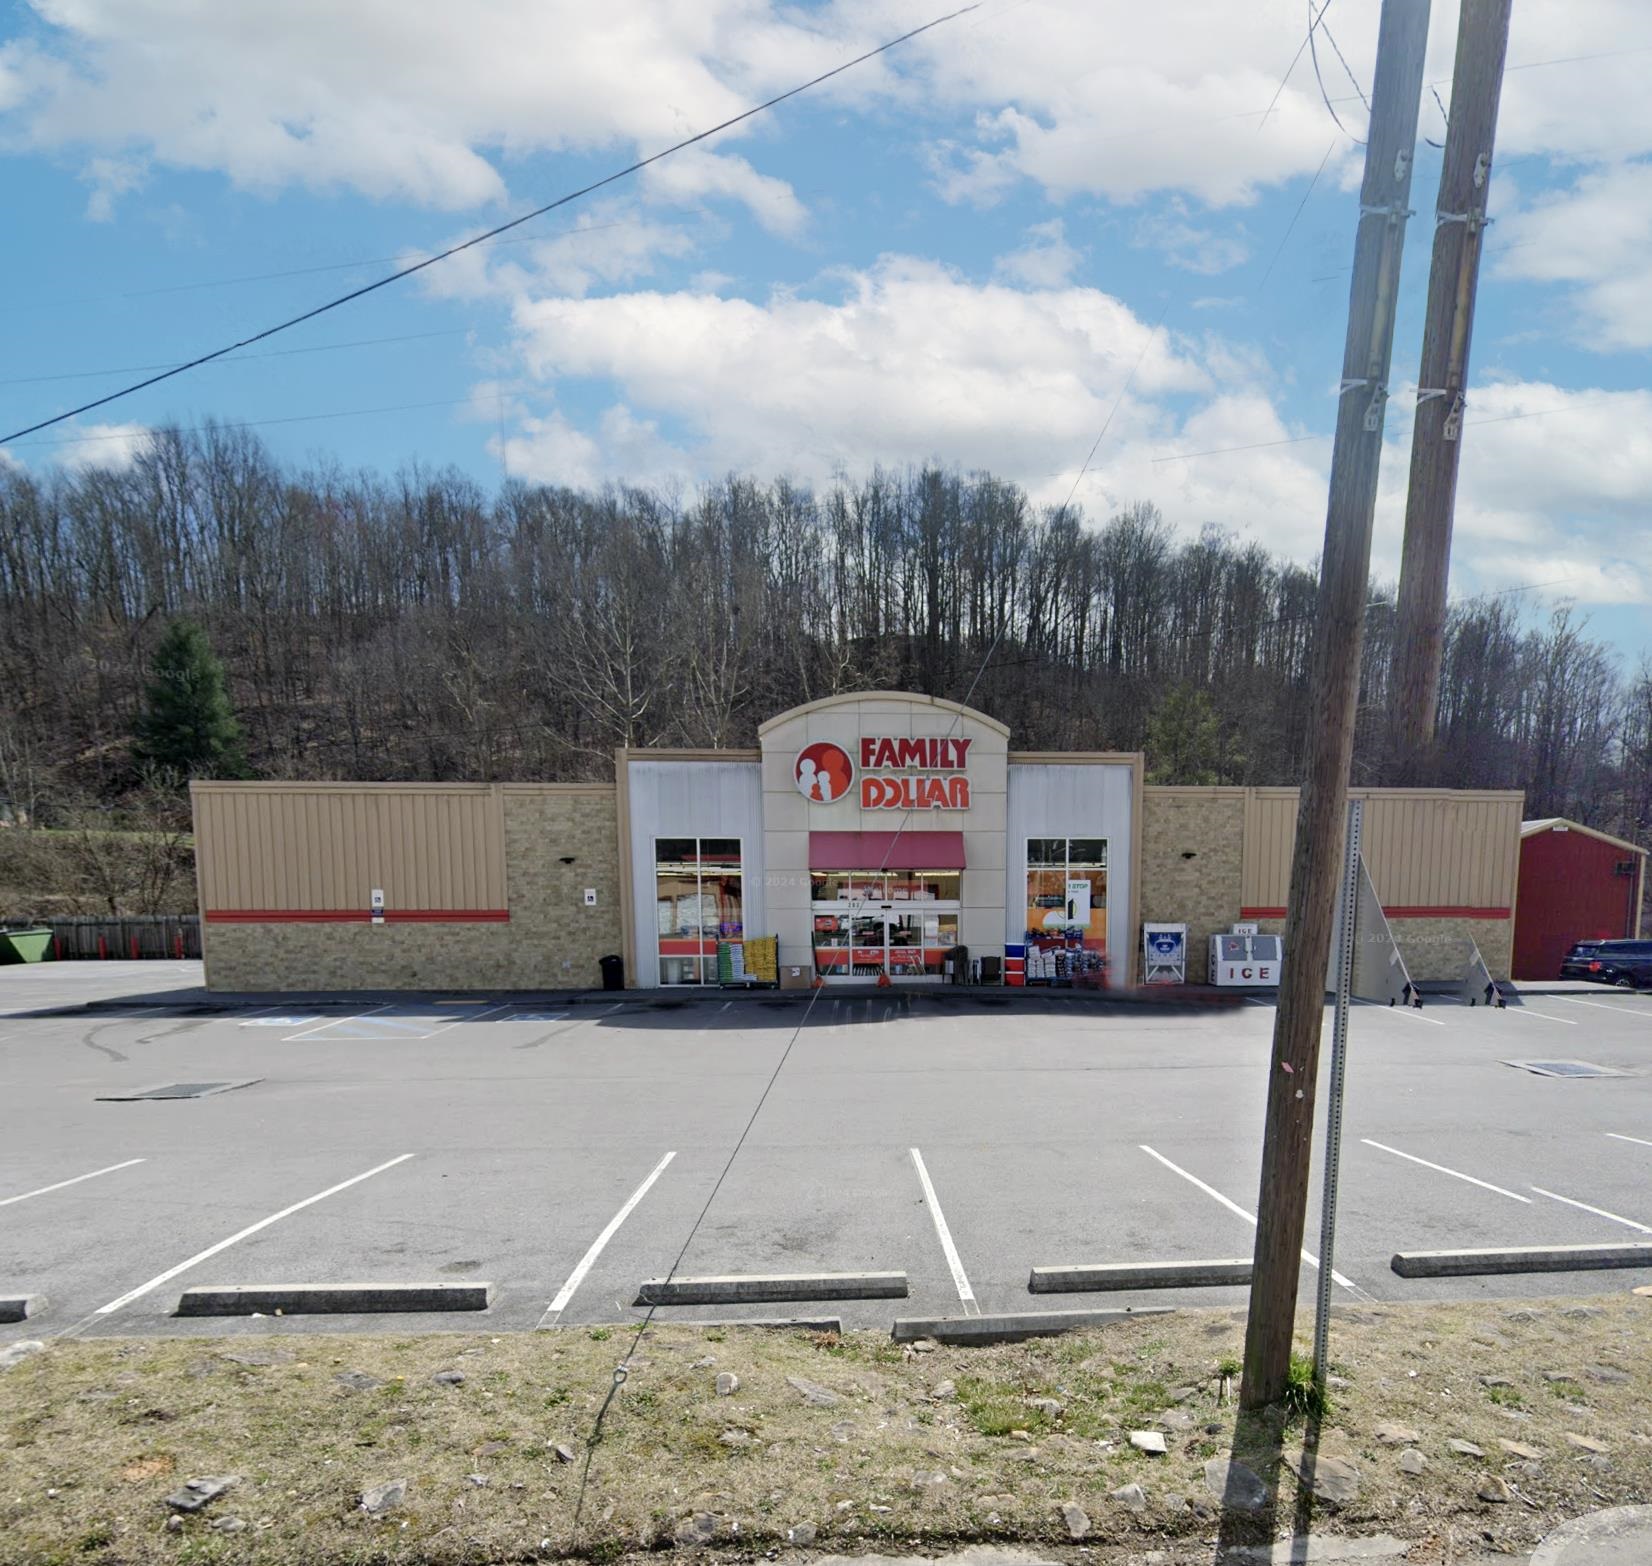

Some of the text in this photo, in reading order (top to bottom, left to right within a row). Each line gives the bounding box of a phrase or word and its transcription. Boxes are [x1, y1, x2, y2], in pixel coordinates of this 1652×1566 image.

[859, 736, 974, 770] FAMILY
[860, 775, 971, 809] DOLLAR
[1229, 967, 1270, 980] ICE
